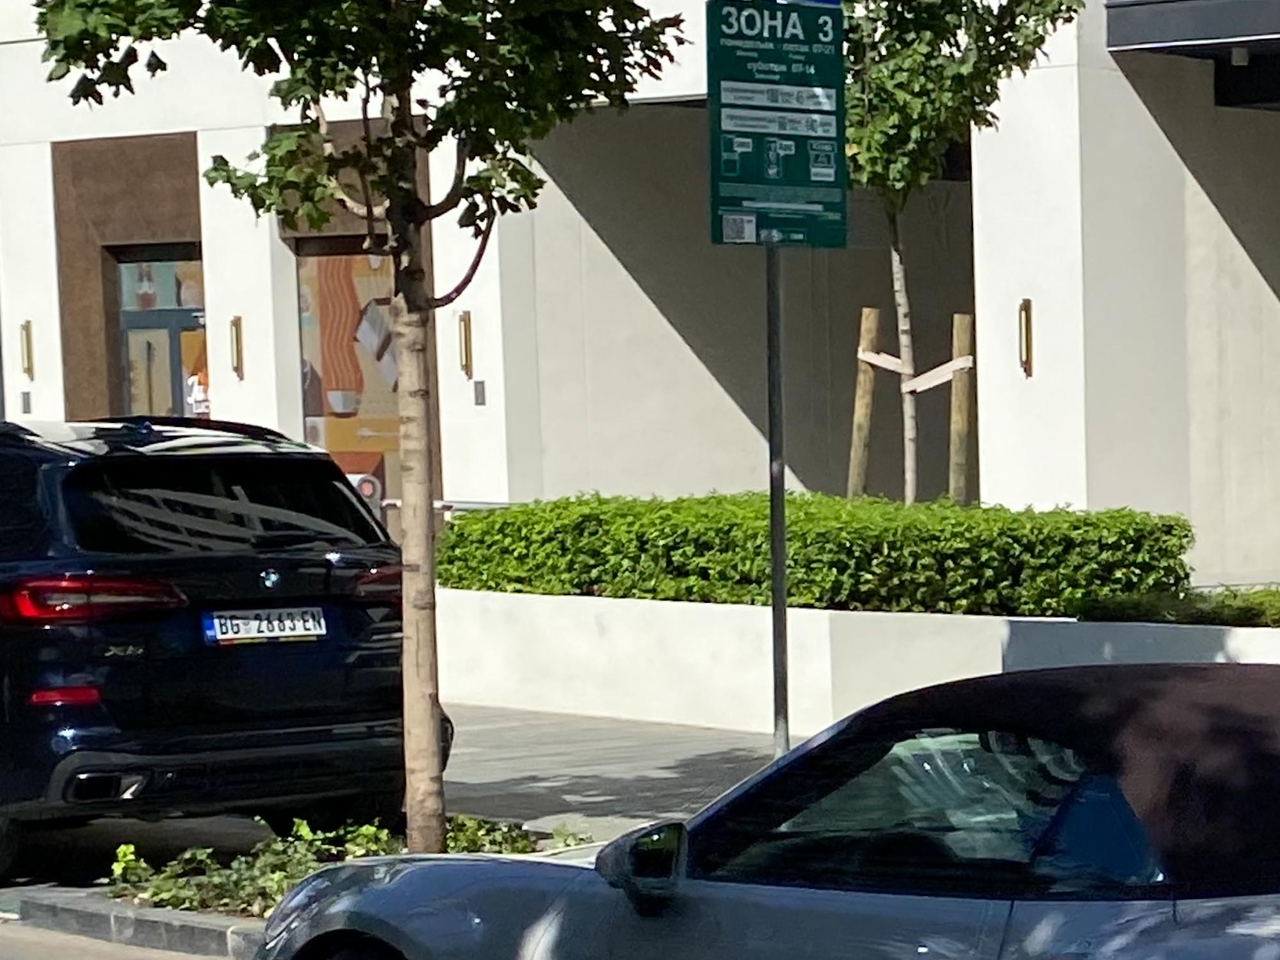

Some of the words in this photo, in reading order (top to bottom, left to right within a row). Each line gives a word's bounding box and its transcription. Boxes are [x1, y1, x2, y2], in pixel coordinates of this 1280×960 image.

[720, 6, 805, 40] ЗОНА
[817, 15, 834, 42] 3
[217, 614, 241, 636] BG
